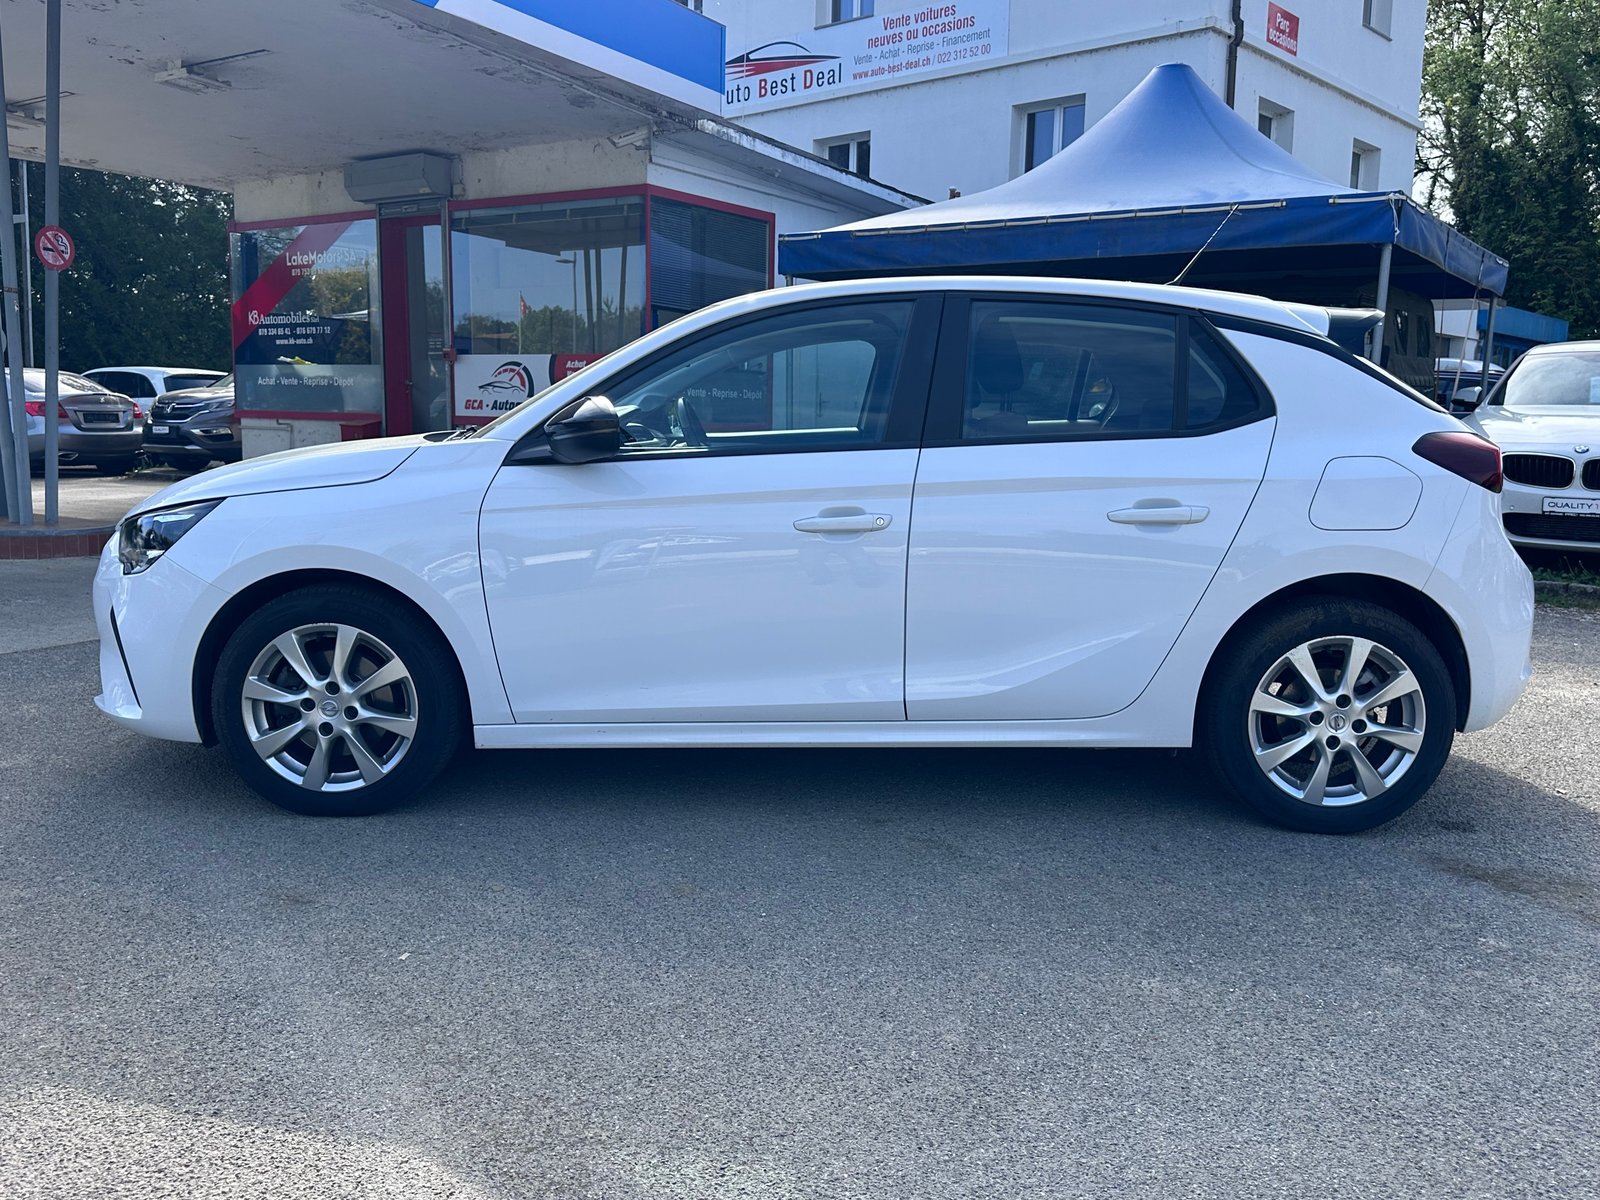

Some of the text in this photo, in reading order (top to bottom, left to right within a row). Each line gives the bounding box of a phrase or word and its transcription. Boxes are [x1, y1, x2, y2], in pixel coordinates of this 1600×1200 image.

[883, 5, 956, 31] Vente voitures
[1276, 13, 1290, 32] Parc
[868, 16, 975, 49] neuves ou occasions
[853, 53, 873, 66] Vente
[880, 48, 900, 60] Achat
[907, 40, 934, 55] Reprise
[942, 28, 991, 47] Financement
[852, 56, 931, 80] www.auto-best-deal.ch
[937, 52, 951, 64] 022
[953, 48, 967, 61] 312
[969, 46, 979, 57] 52
[981, 43, 991, 55] 00
[726, 63, 842, 105] uto Best Deal
[566, 360, 587, 369] Achat
[258, 377, 275, 385] Achat
[280, 377, 298, 385] Vente
[303, 377, 328, 387] Reprise
[712, 388, 738, 399] Reprise
[464, 399, 483, 411] GCA
[1547, 501, 1593, 510] QUALITY
